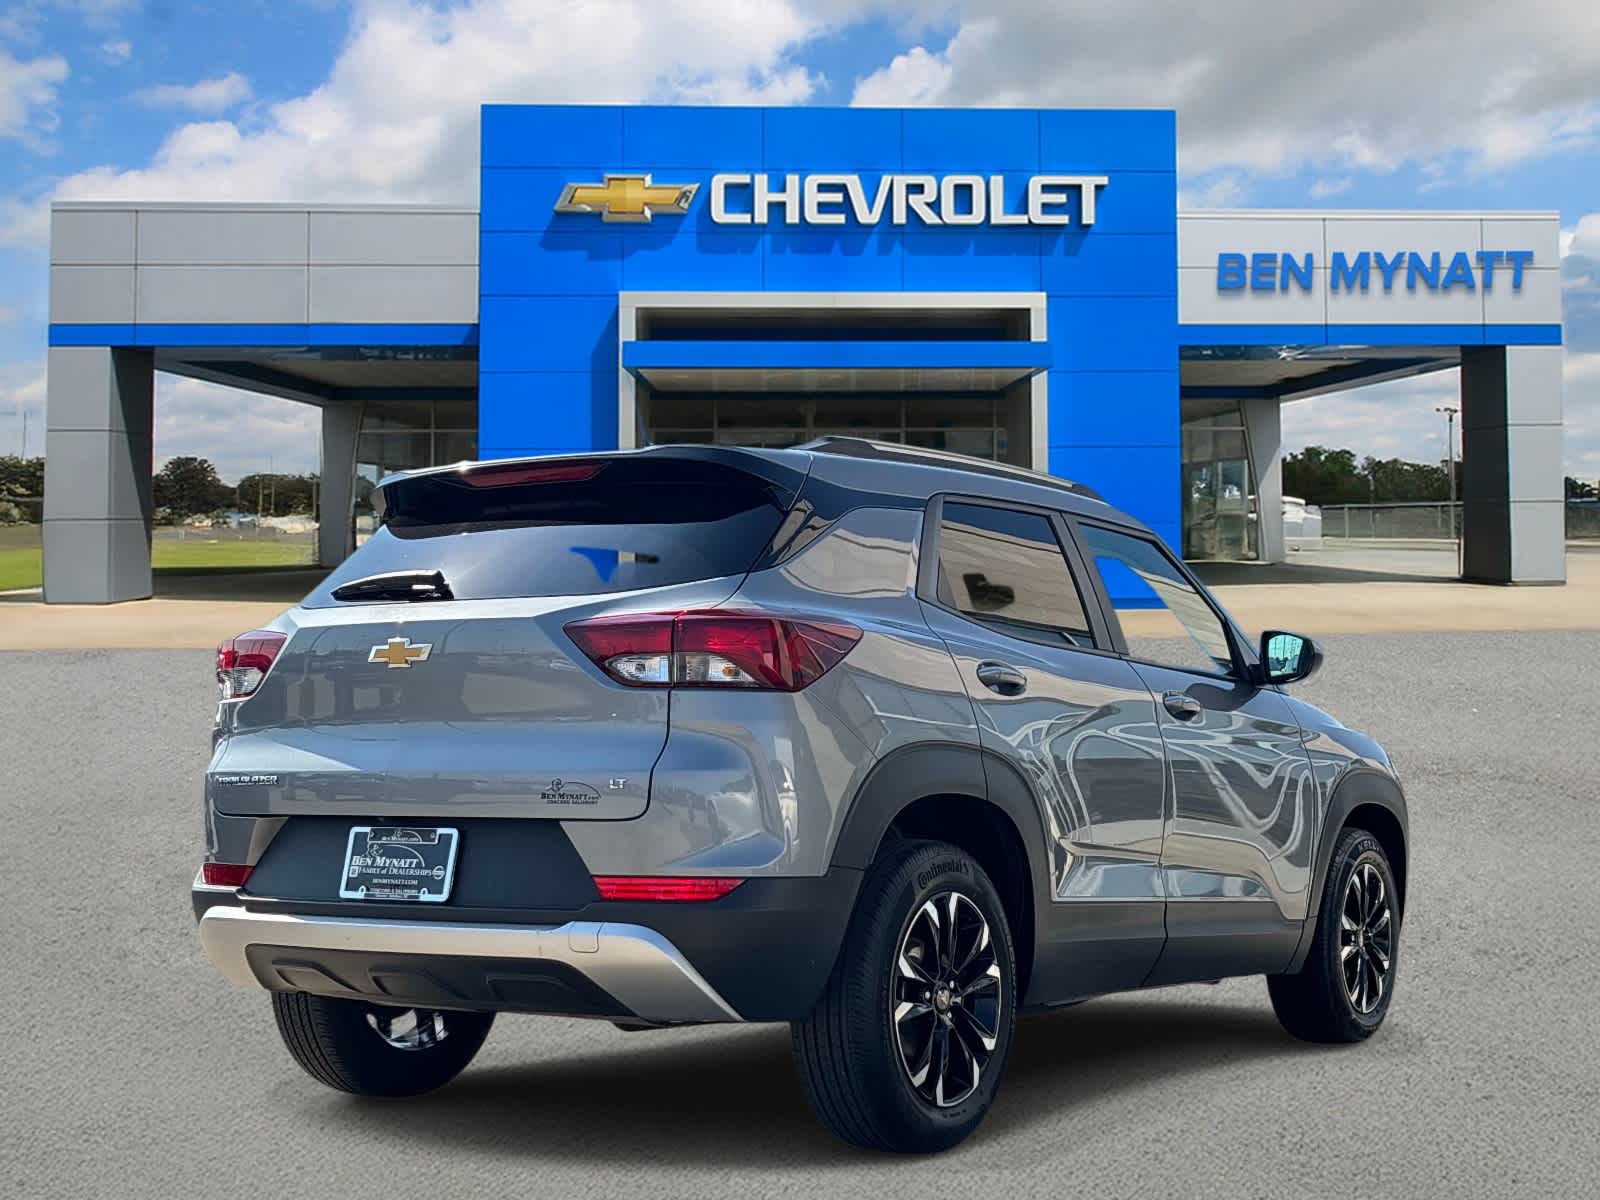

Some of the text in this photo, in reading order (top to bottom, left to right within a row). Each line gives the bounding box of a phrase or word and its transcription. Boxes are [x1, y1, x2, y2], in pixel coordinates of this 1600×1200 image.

[710, 173, 1109, 225] CHEVROLET
[1217, 250, 1534, 290] BEN MYNATT
[609, 778, 627, 789] LT
[351, 855, 420, 868] BEN MYNATT
[388, 867, 433, 877] DEALERSHIPS
